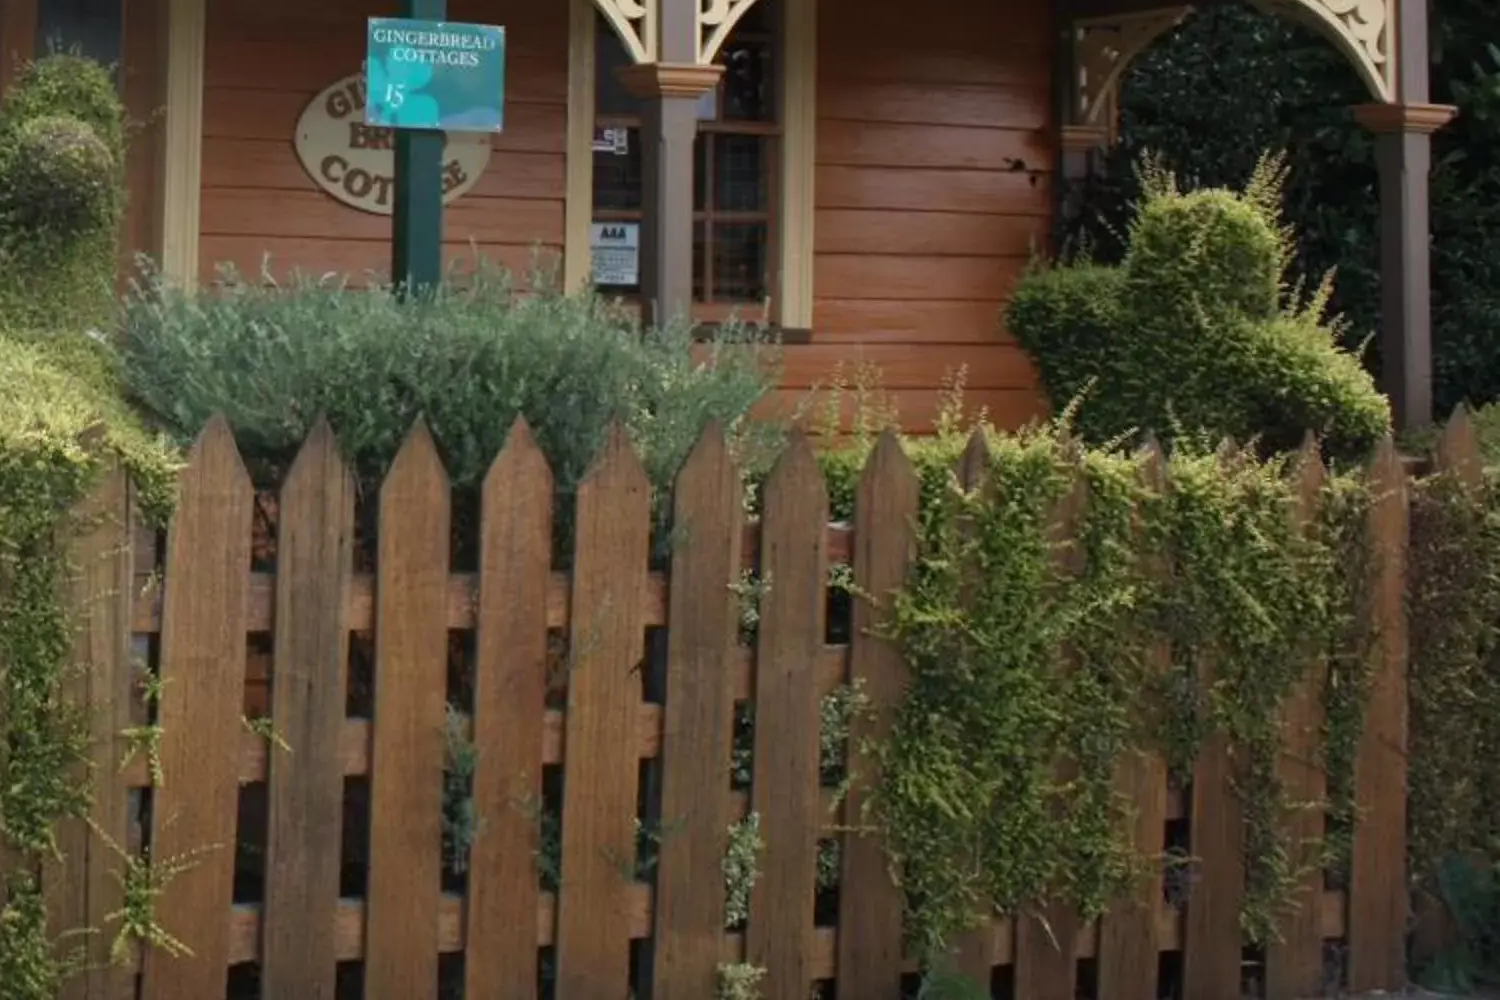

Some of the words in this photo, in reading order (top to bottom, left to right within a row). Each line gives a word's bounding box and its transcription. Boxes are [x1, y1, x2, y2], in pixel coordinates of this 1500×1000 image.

[373, 28, 496, 50] GINGERBREAD
[392, 47, 480, 67] COTTAGES
[384, 83, 405, 109] 15
